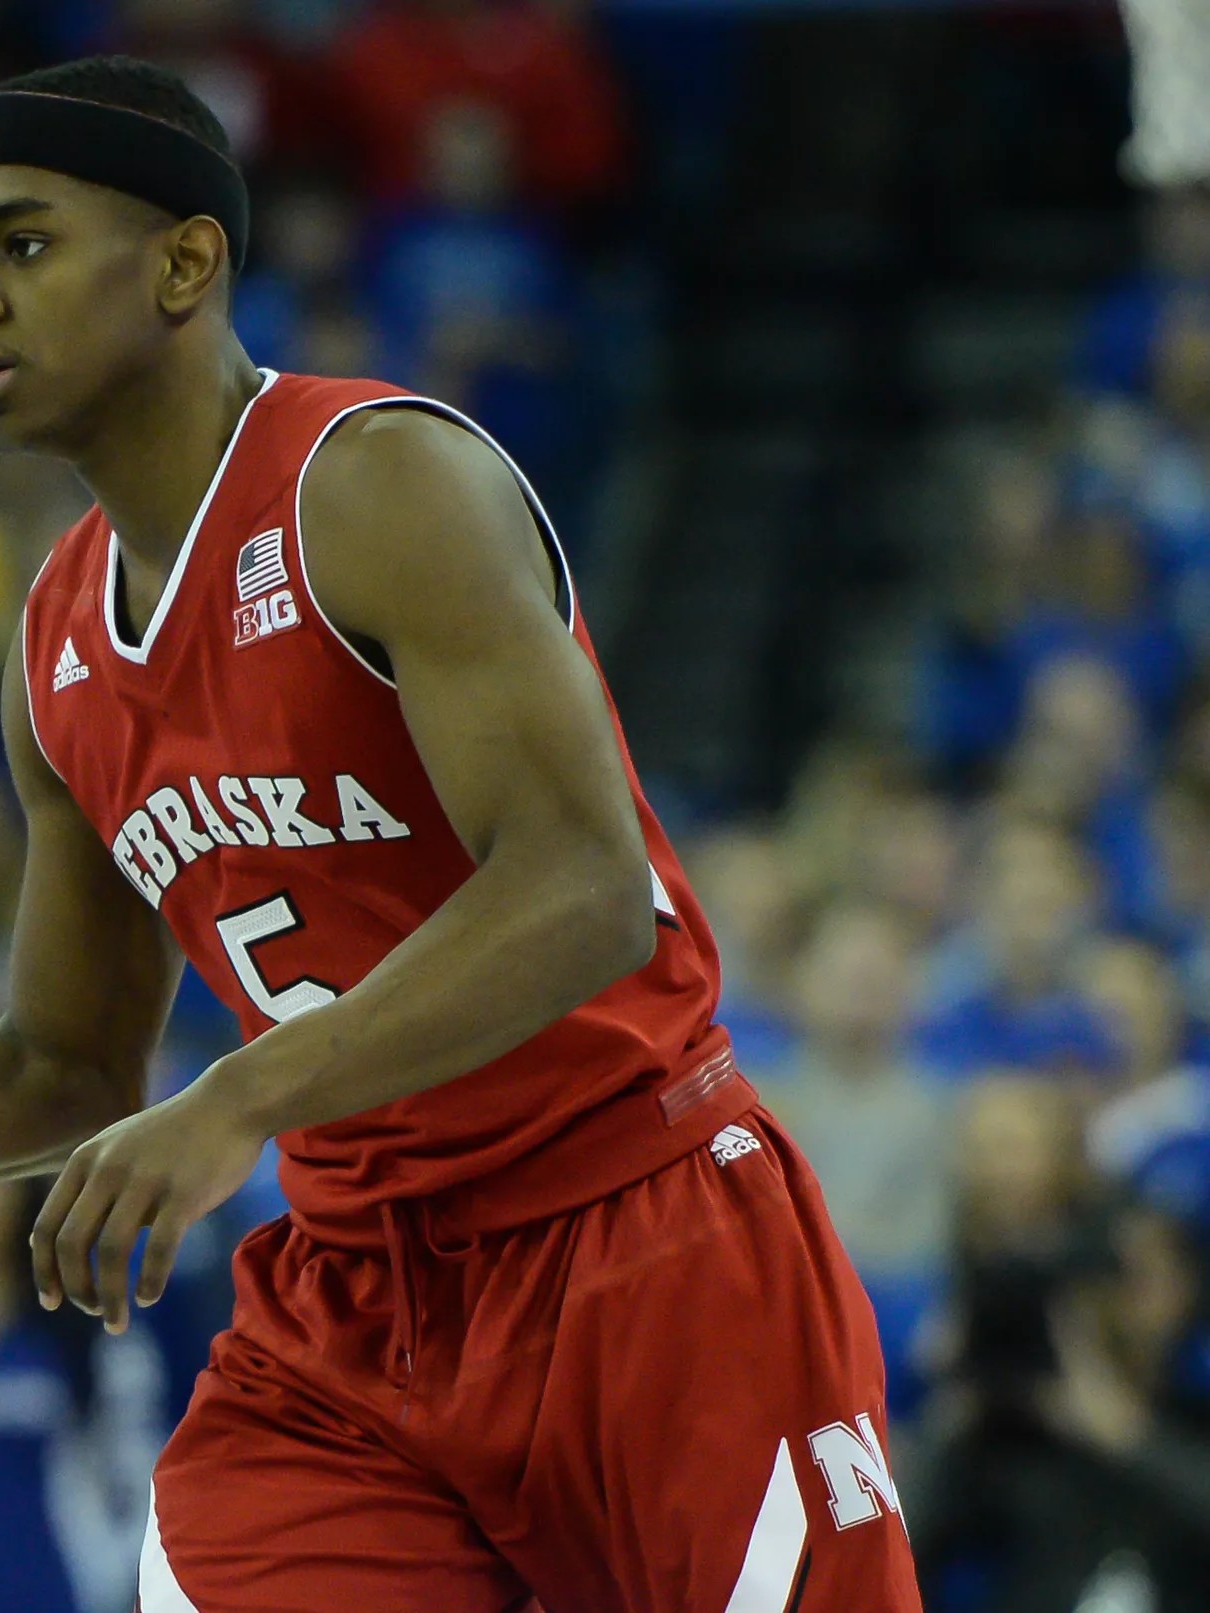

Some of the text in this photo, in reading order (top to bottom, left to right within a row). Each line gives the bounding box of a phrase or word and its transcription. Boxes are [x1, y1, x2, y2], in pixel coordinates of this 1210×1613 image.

[53, 665, 90, 692] adidas
[112, 774, 411, 911] EBRASKA
[215, 892, 339, 1025] 5
[806, 1411, 897, 1532] N
